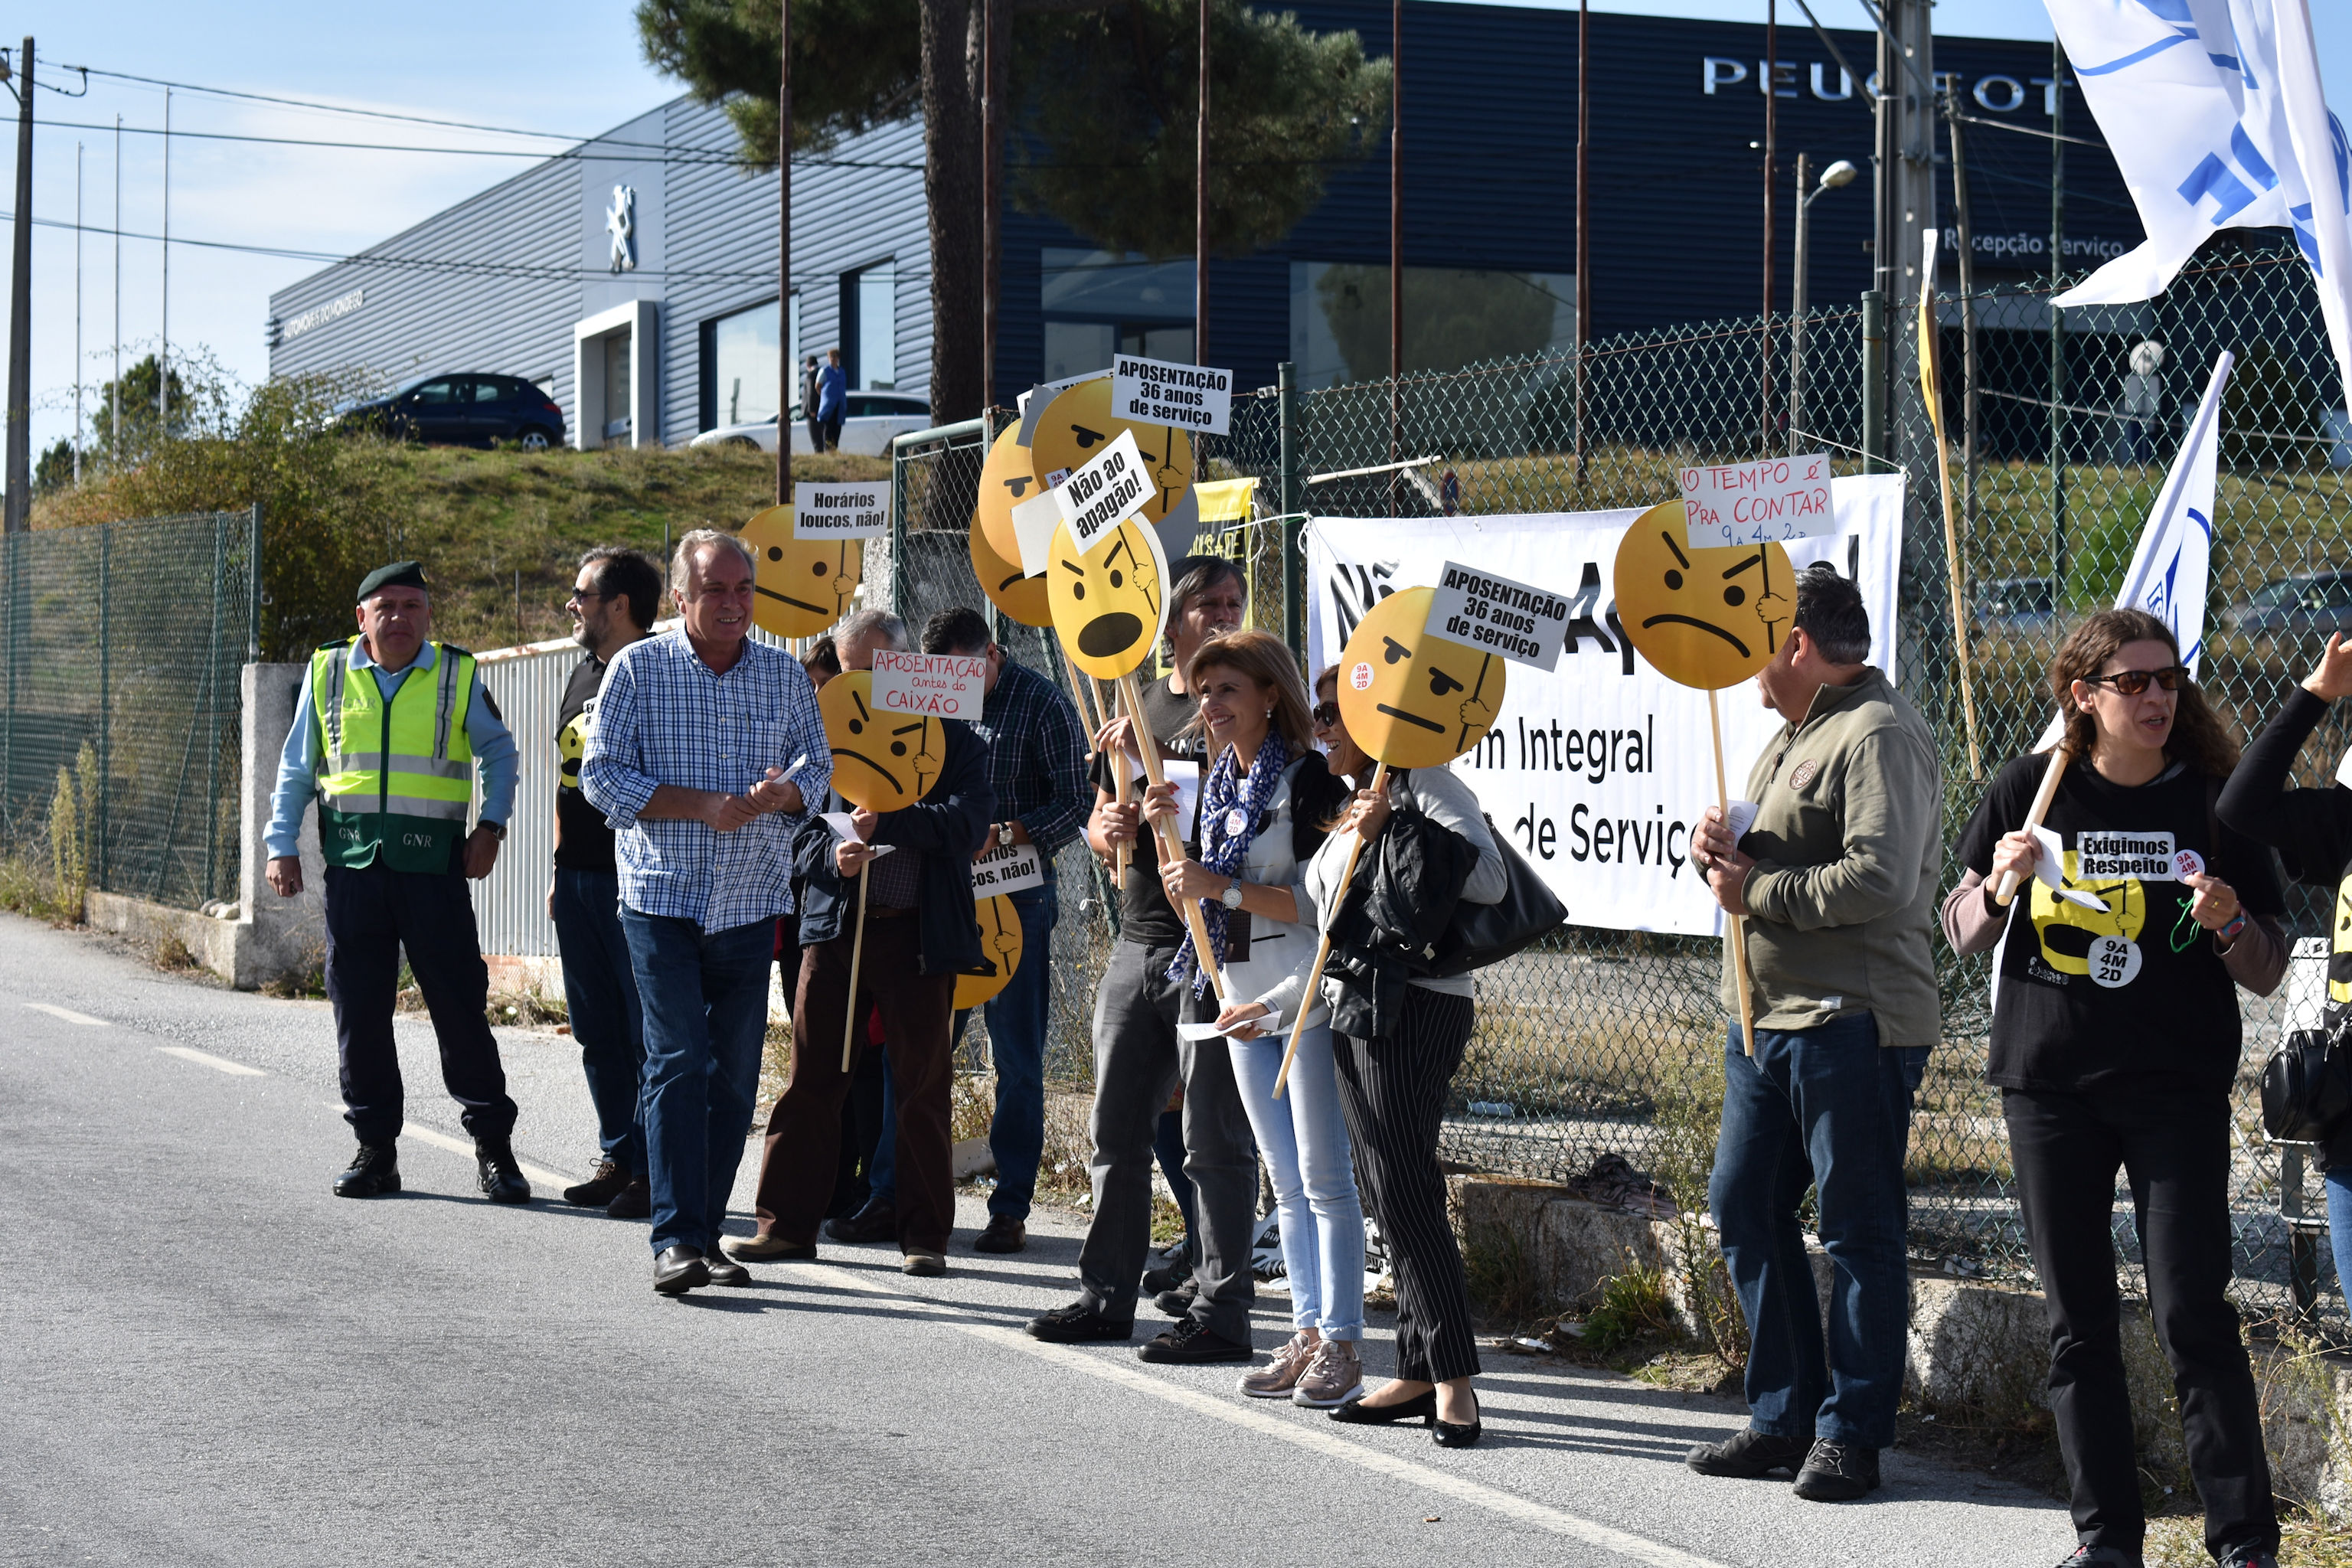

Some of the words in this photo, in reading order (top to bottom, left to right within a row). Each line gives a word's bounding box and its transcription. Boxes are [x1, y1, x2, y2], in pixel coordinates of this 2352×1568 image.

[1703, 56, 2073, 115] PEUOT
[1944, 227, 2043, 259] Rcepção
[1119, 361, 1227, 391] APOSENTAÇÃO
[1141, 382, 1160, 399] 36
[1165, 388, 1203, 406] anos
[1129, 399, 1148, 415] de
[1152, 405, 1212, 426] serviço
[1050, 473, 1063, 482] 9A
[1067, 472, 1103, 508] Não
[1102, 452, 1125, 480] ao
[1683, 469, 1699, 492] O
[1706, 462, 1789, 492] TEMPO
[1803, 460, 1821, 480] é
[814, 492, 875, 508] Horários
[1076, 469, 1142, 539] apagão!
[1734, 488, 1827, 523] CONTAR
[800, 512, 852, 528] loucos,
[855, 511, 884, 527] não!
[1443, 569, 1566, 621] APOSENTAÇÃO
[1464, 597, 1489, 619] 36
[1491, 607, 1534, 634] anos
[1446, 616, 1468, 635] de
[1472, 626, 1540, 658] serviço
[875, 652, 985, 678] APOSENTAÇÃO
[912, 676, 947, 689] antes
[952, 679, 966, 691] do
[343, 697, 376, 709] GNR
[1518, 714, 1653, 784] Integral
[338, 827, 361, 842] GNR
[403, 833, 432, 848] GNR
[1514, 802, 1556, 860] de
[1570, 803, 1698, 880] Serviç
[2083, 837, 2168, 856] Exigimos
[1001, 858, 1035, 880] não!
[2083, 858, 2168, 875] Respeito
[2177, 853, 2191, 864] 9A
[2182, 861, 2197, 873] 4M
[2105, 940, 2128, 954] 9A
[2100, 953, 2127, 968] 4M
[2097, 967, 2122, 982] 2D
